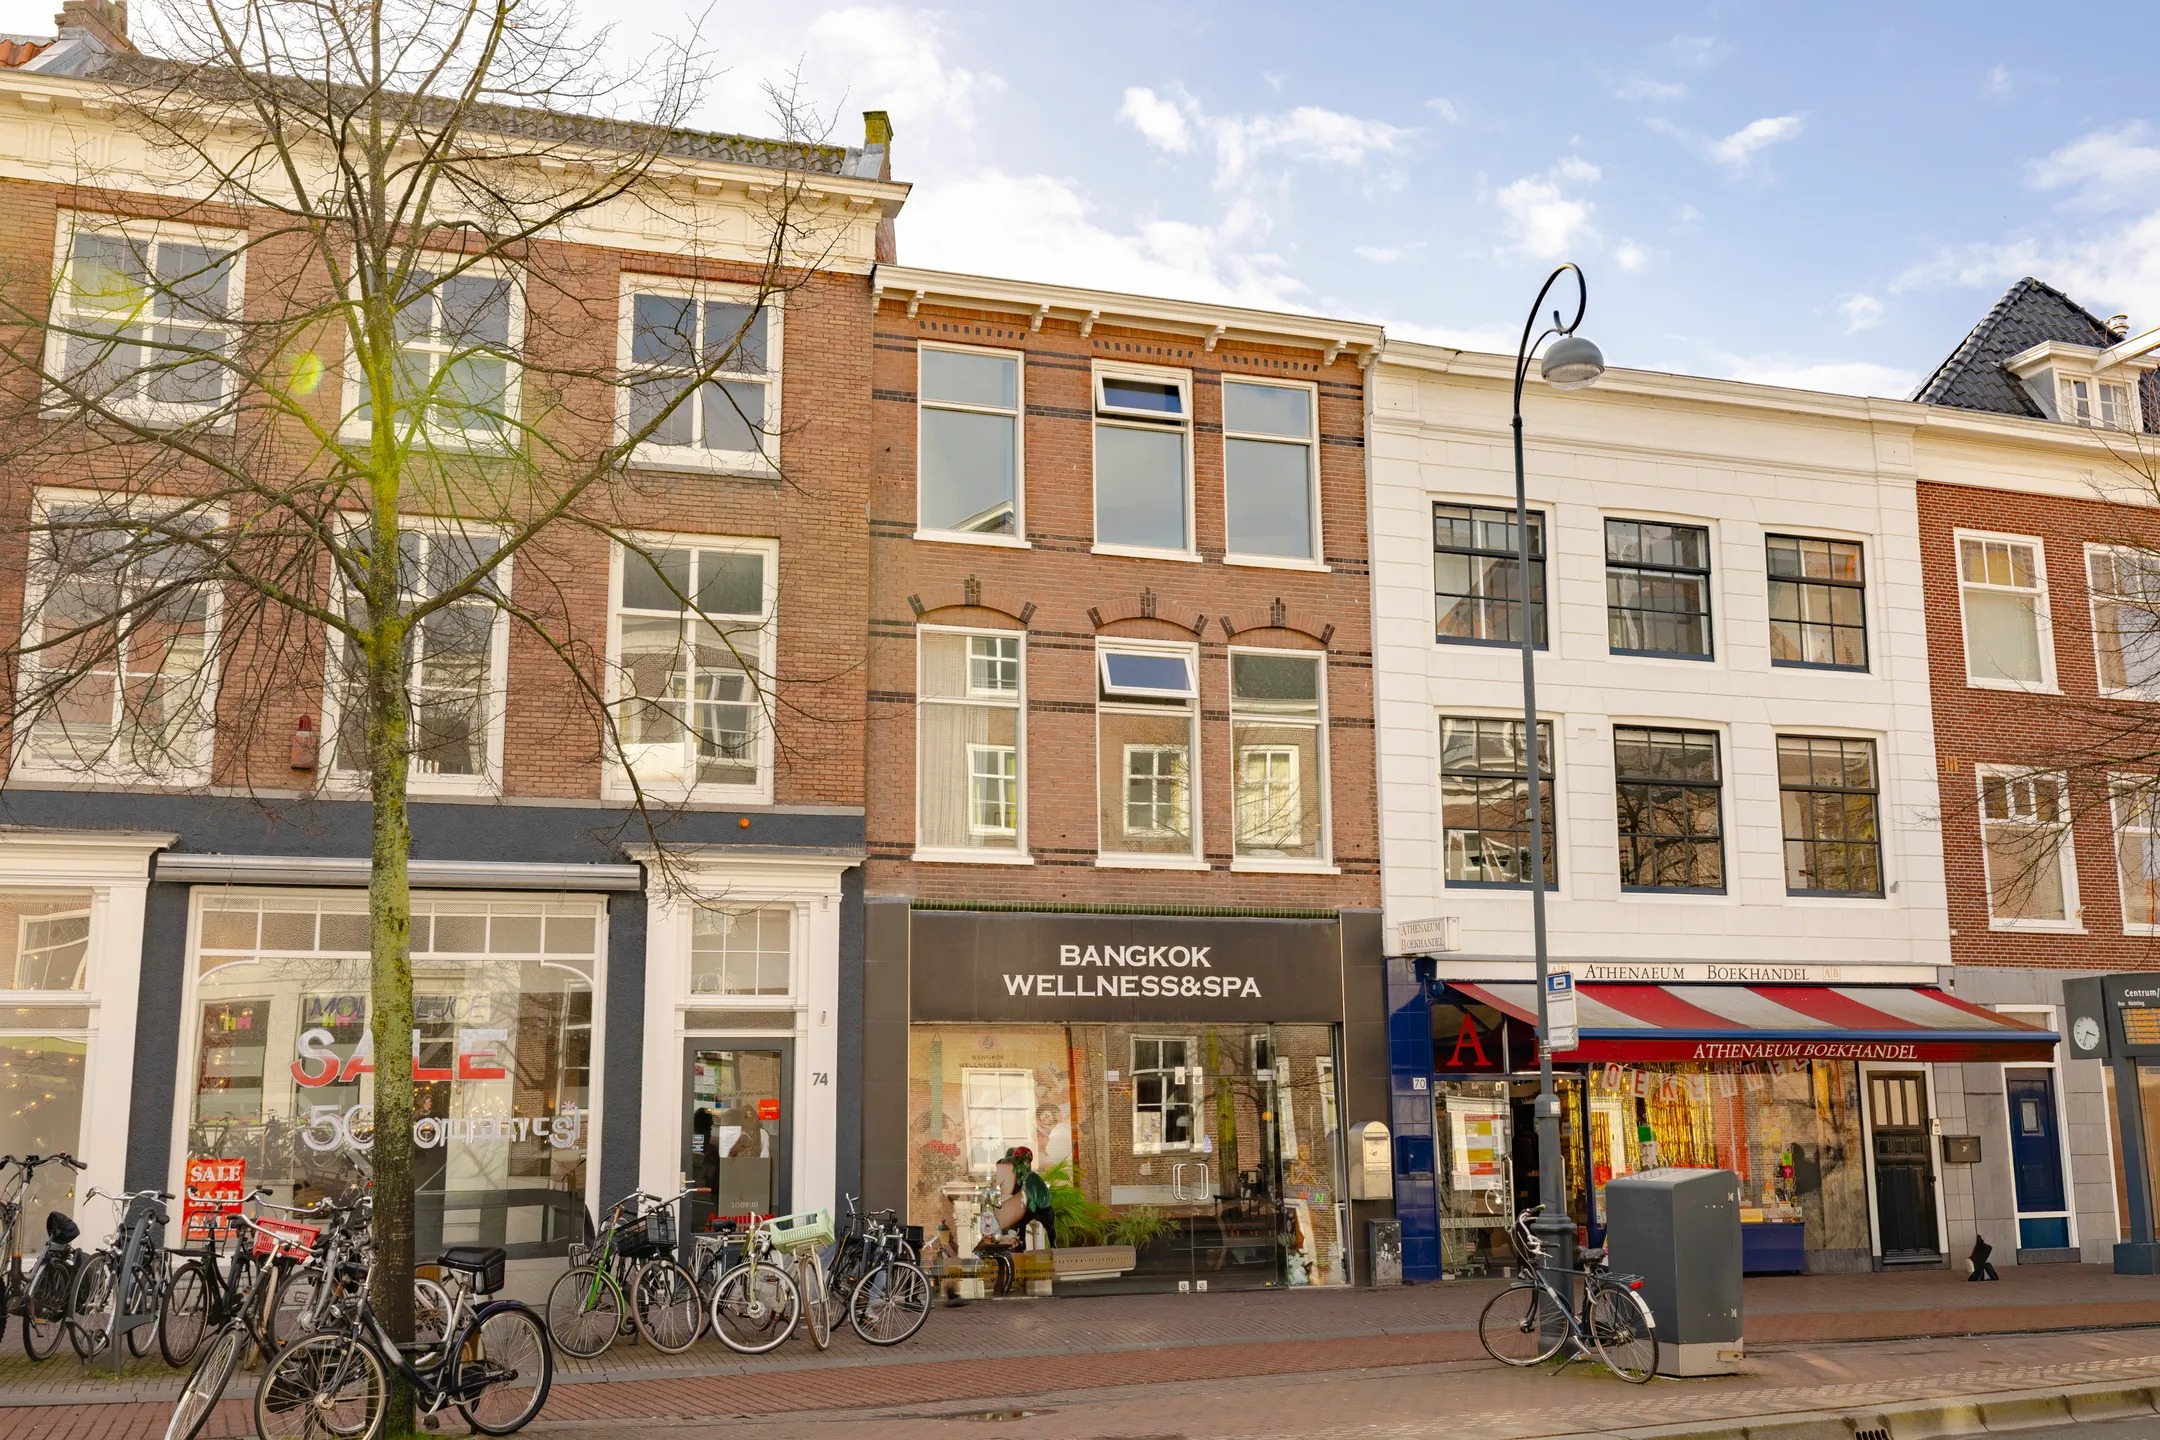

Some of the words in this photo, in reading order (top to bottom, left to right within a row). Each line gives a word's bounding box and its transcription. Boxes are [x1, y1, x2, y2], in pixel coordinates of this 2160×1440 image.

[1401, 922, 1441, 936] ATHENAEUM
[1401, 938, 1445, 951] BOEKHANDEL
[1059, 944, 1212, 968] BANGKOK
[1584, 964, 1685, 980] ATHENAEUM
[1706, 965, 1810, 981] BOEKHANDEL
[1002, 974, 1262, 998] WELLNESS&SPA
[1446, 1012, 1493, 1066] A
[289, 1028, 509, 1088] SALE
[1692, 1043, 1804, 1060] ATHENAEUM
[1803, 1043, 1919, 1060] BOEKHANDEL
[812, 1072, 829, 1087] 74
[1413, 1079, 1426, 1089] 70
[190, 1165, 241, 1182] SALE
